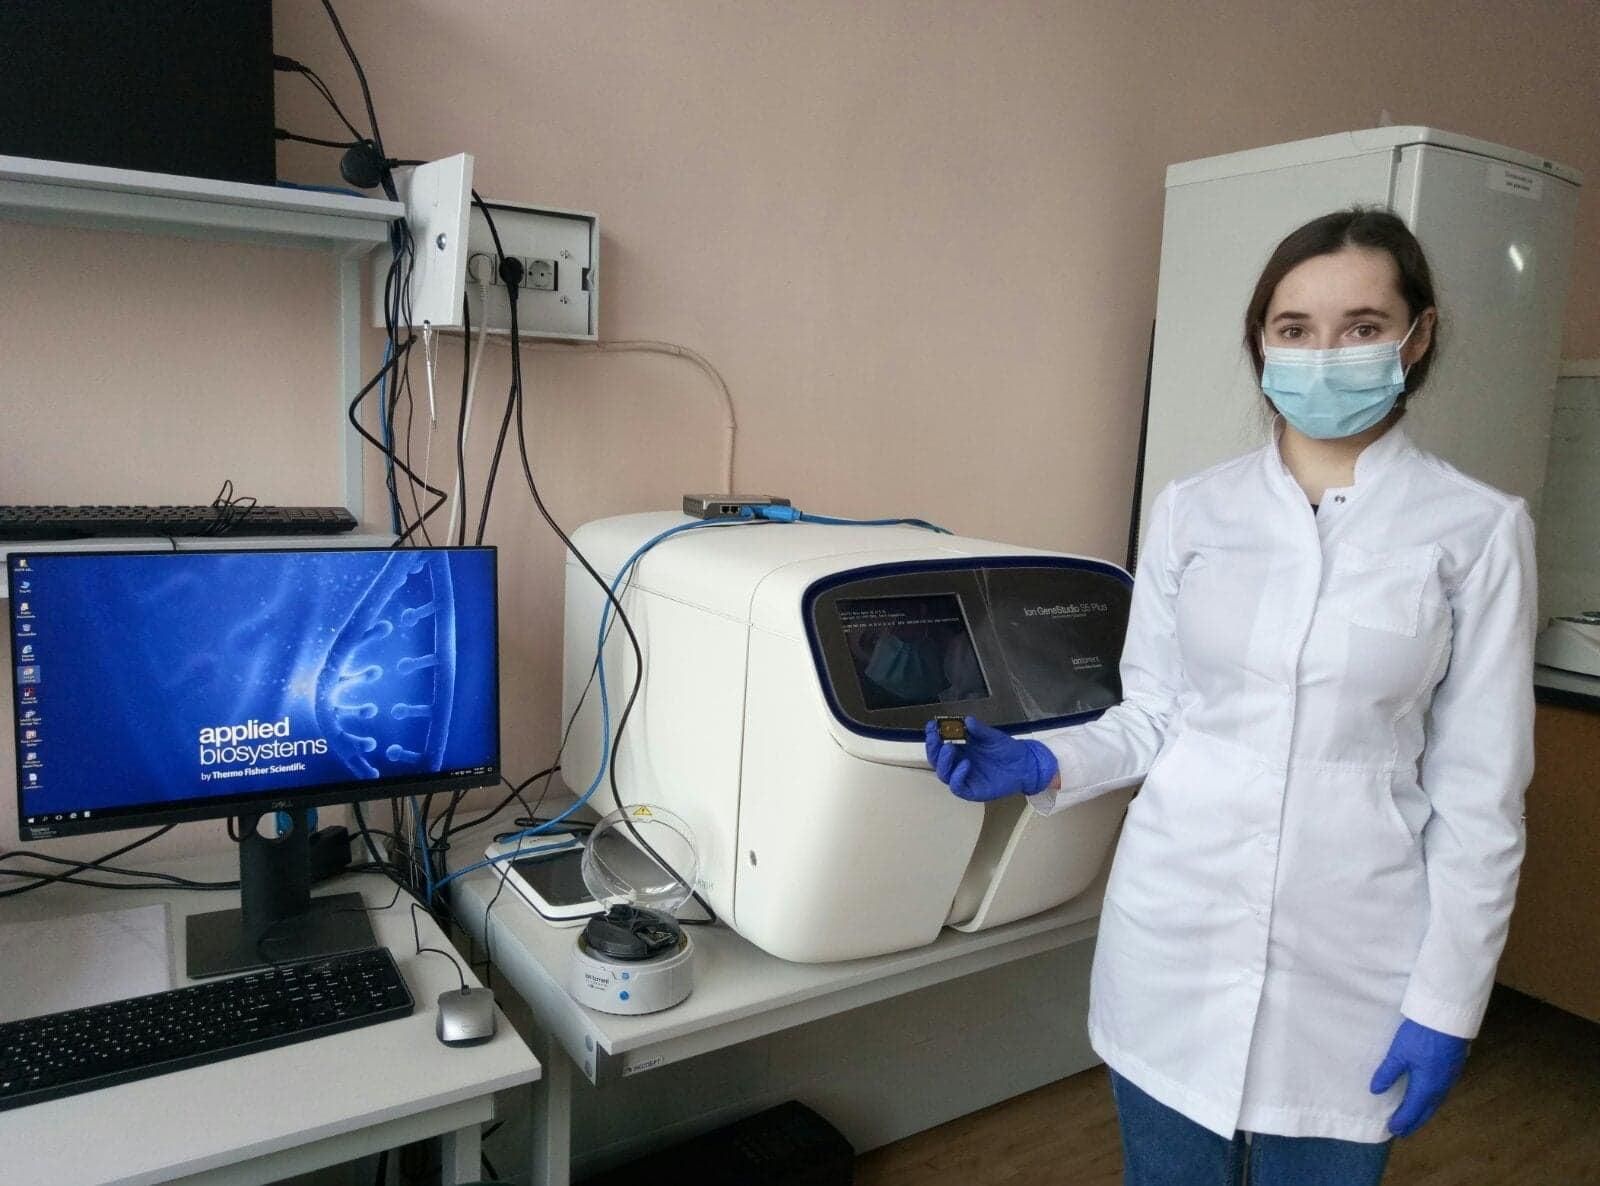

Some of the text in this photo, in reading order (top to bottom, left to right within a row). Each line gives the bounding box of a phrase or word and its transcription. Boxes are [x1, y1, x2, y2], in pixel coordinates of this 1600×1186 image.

[199, 716, 290, 747] applied
[200, 738, 328, 765] biosystems
[201, 762, 306, 781] by Thermo Fisher Scientific
